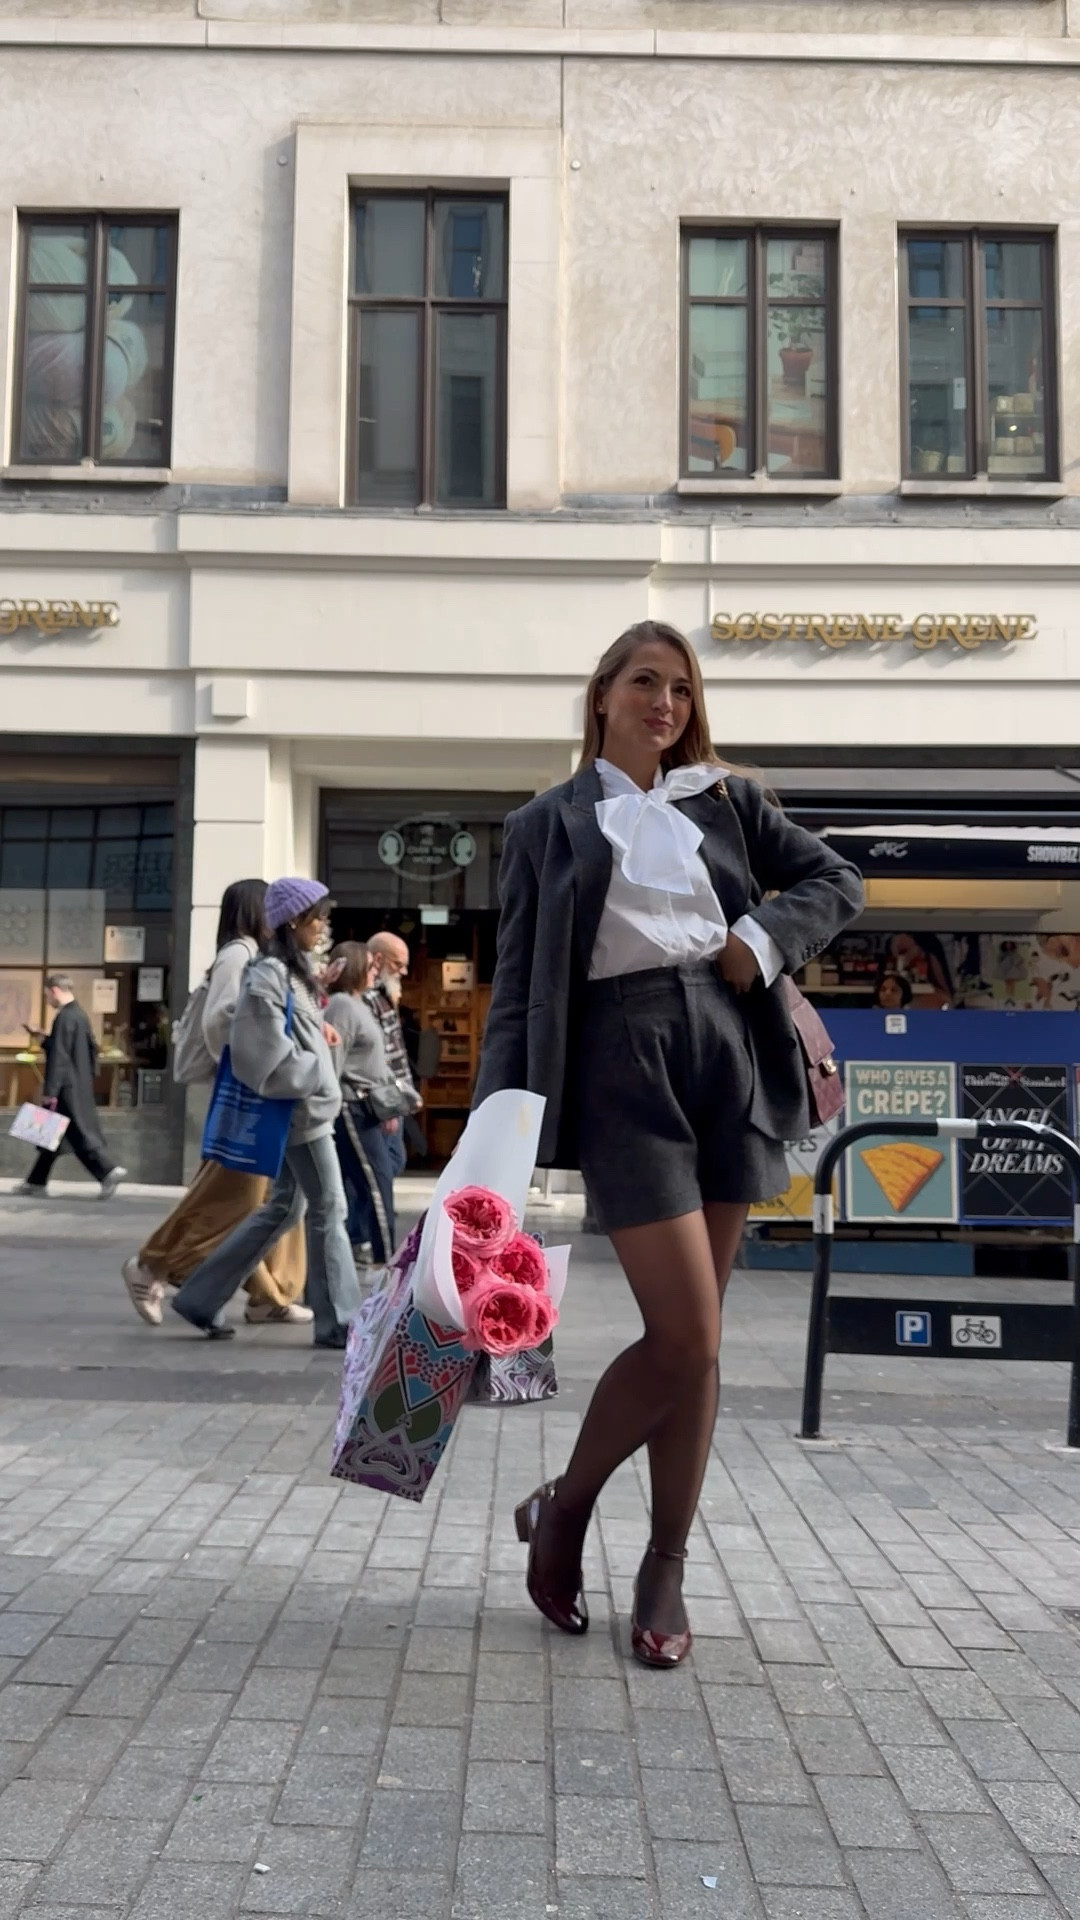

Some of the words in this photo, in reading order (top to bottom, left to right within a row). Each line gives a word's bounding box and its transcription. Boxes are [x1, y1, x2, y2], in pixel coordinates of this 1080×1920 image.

[711, 611, 904, 649] SØSTRENE
[911, 613, 1037, 650] GRENE
[855, 1069, 891, 1085] WHO
[894, 1069, 936, 1086] GIVES
[937, 1070, 948, 1085] A
[857, 1086, 946, 1115] CRÊPE?
[968, 1152, 1064, 1175] DREAMS
[902, 1315, 924, 1342] P
